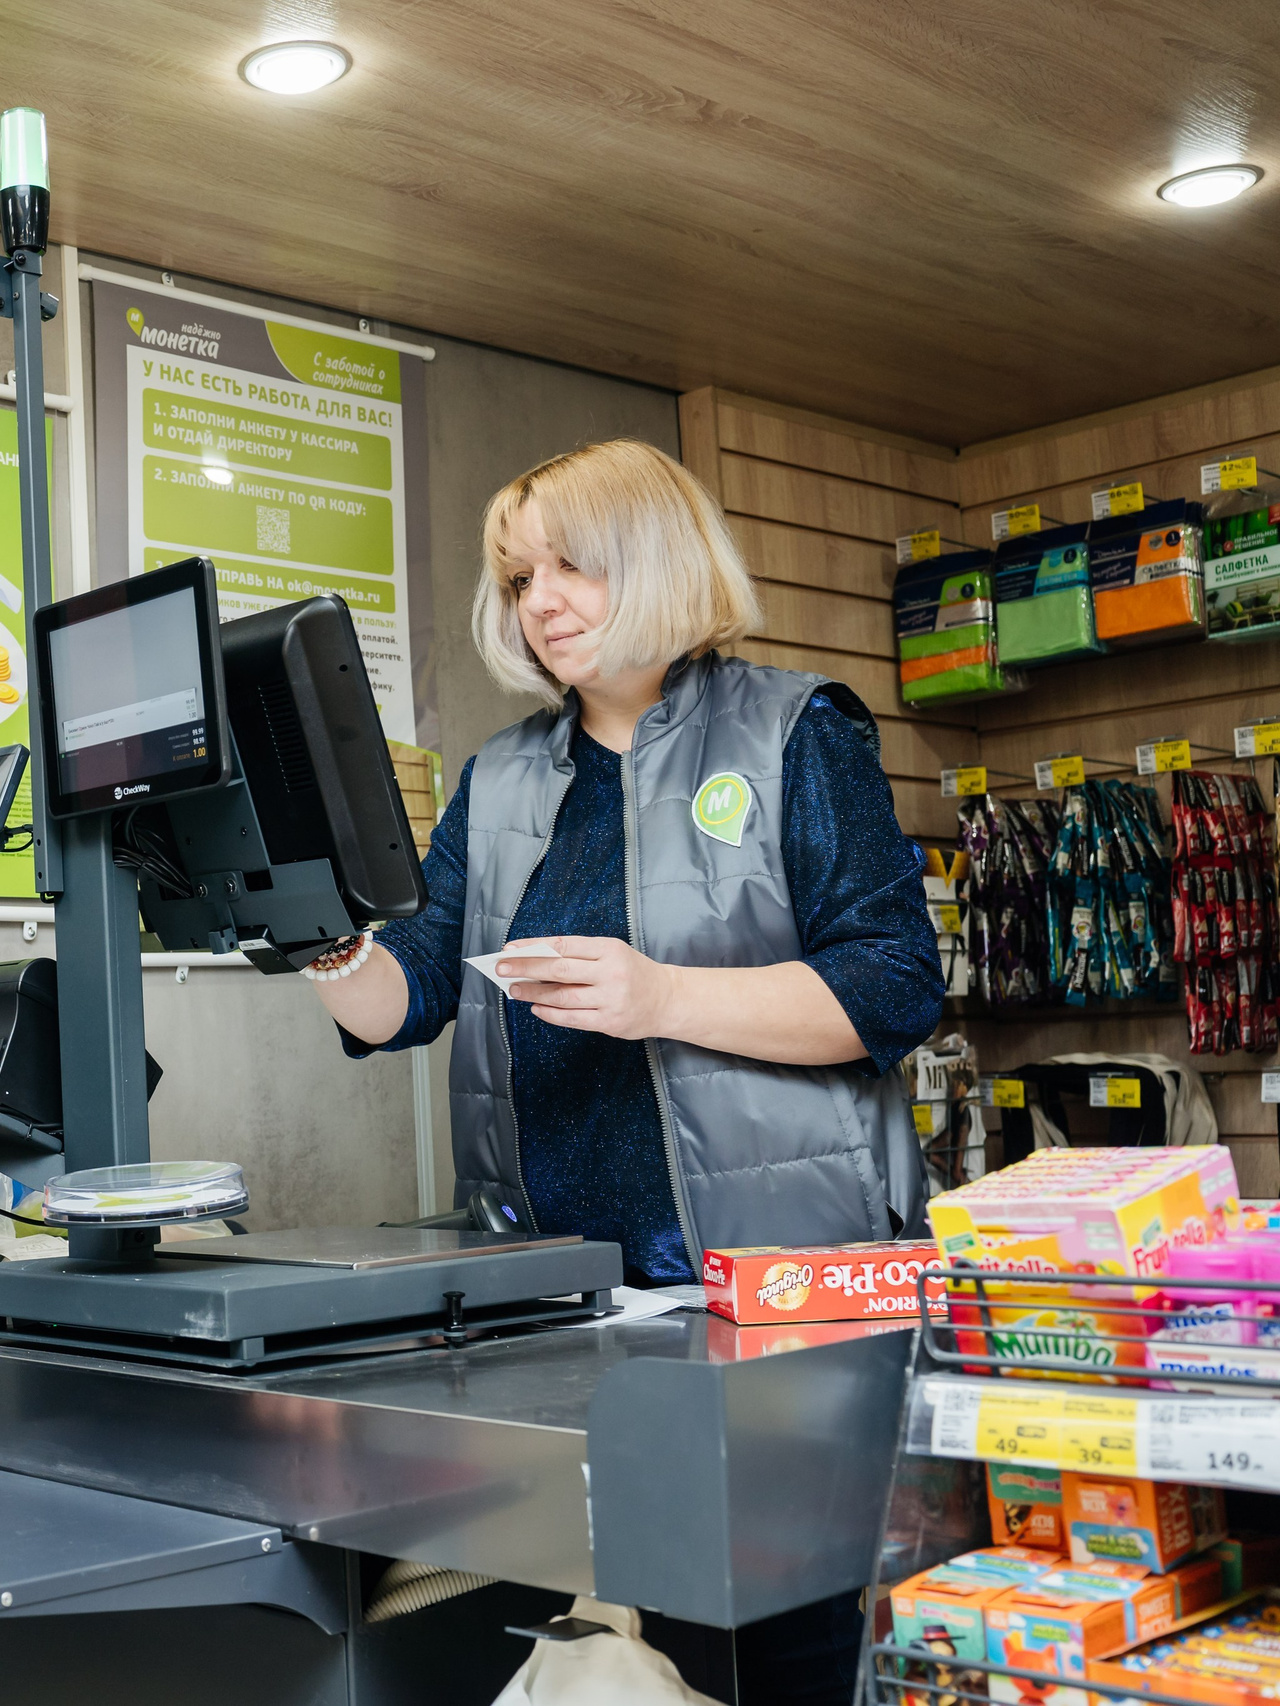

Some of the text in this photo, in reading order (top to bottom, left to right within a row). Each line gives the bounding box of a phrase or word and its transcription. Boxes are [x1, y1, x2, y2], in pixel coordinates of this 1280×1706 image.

[181, 323, 221, 340] надёжно
[313, 351, 386, 381] С заботой о
[142, 359, 393, 428] У НАС ЕСТЬ РАБОТА ДЛЯ ВАС!
[312, 370, 384, 396] сотрудниках
[154, 402, 359, 455] 1. ЗАПОЛНИ АНКЕТУ У КАССИРА
[153, 423, 293, 462] И ОТДАЙ ДИРЕКТОРУ
[154, 468, 367, 516] 2. ЗАПОЛНИ АНКЕТУ ПО QR КОДУ:
[1234, 529, 1278, 544] ПРАВИЛЬНОЕ
[1234, 538, 1265, 550] РЕШЕНИЕ
[1215, 554, 1268, 575] САЛФЕТКА
[216, 568, 263, 587] ТПРАВЬ
[267, 576, 284, 590] НА
[218, 599, 241, 609] ИКОВ
[362, 634, 398, 645] оплатой.
[372, 681, 395, 692] фику.
[192, 746, 207, 758] 1.00
[123, 784, 151, 796] CheckWay
[756, 1264, 814, 1306] Original
